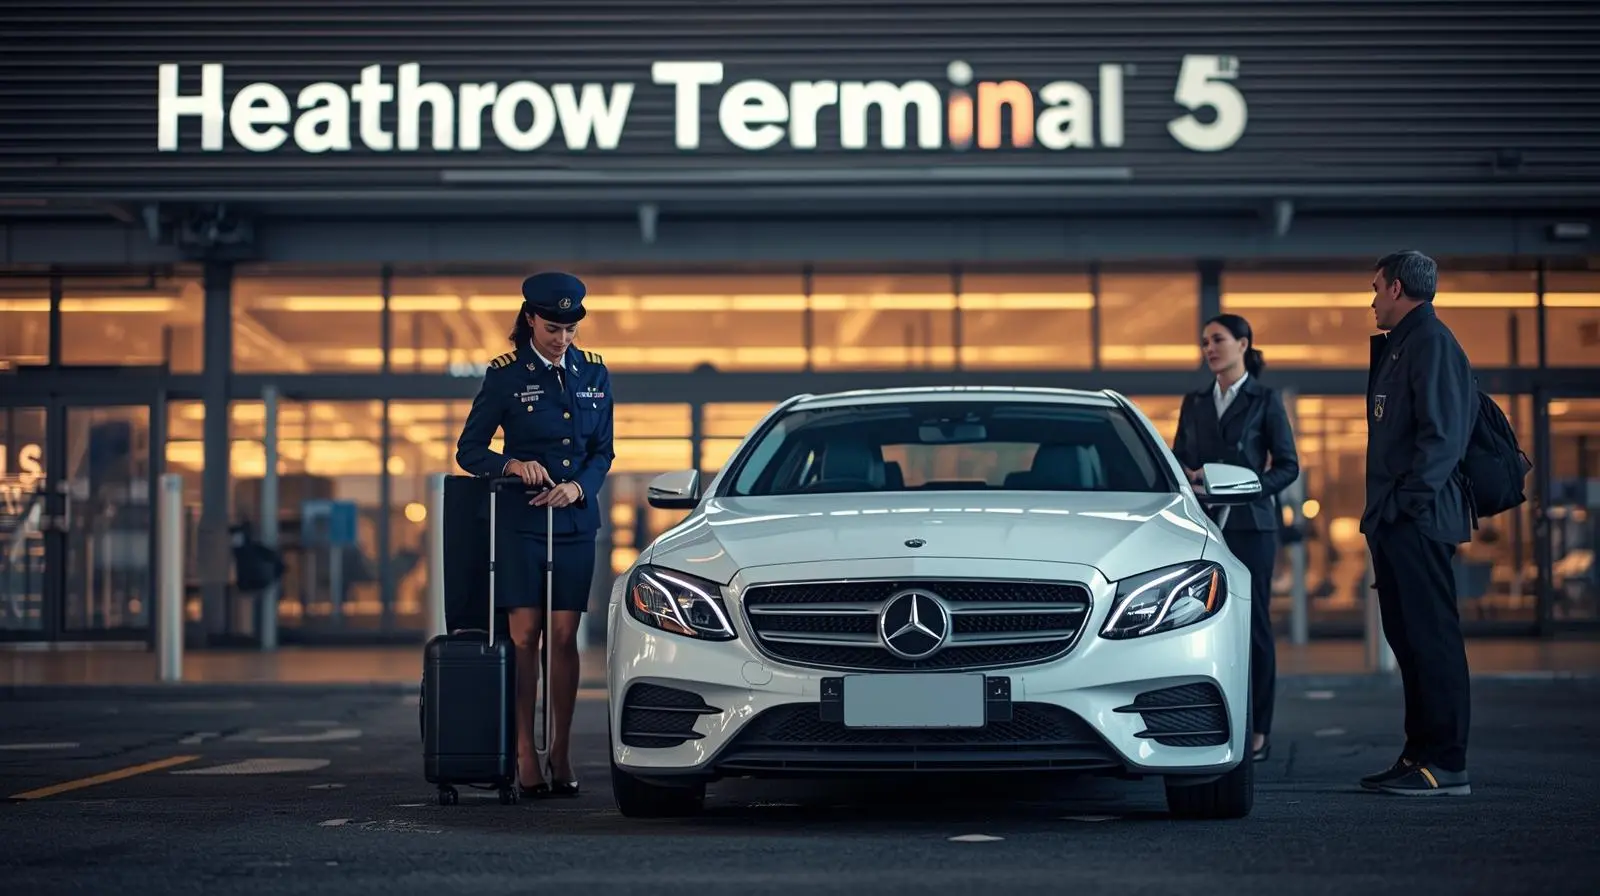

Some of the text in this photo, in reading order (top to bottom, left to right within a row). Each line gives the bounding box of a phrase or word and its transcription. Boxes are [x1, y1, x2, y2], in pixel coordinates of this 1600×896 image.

[157, 55, 1247, 152] Heathrow Terminal 5
